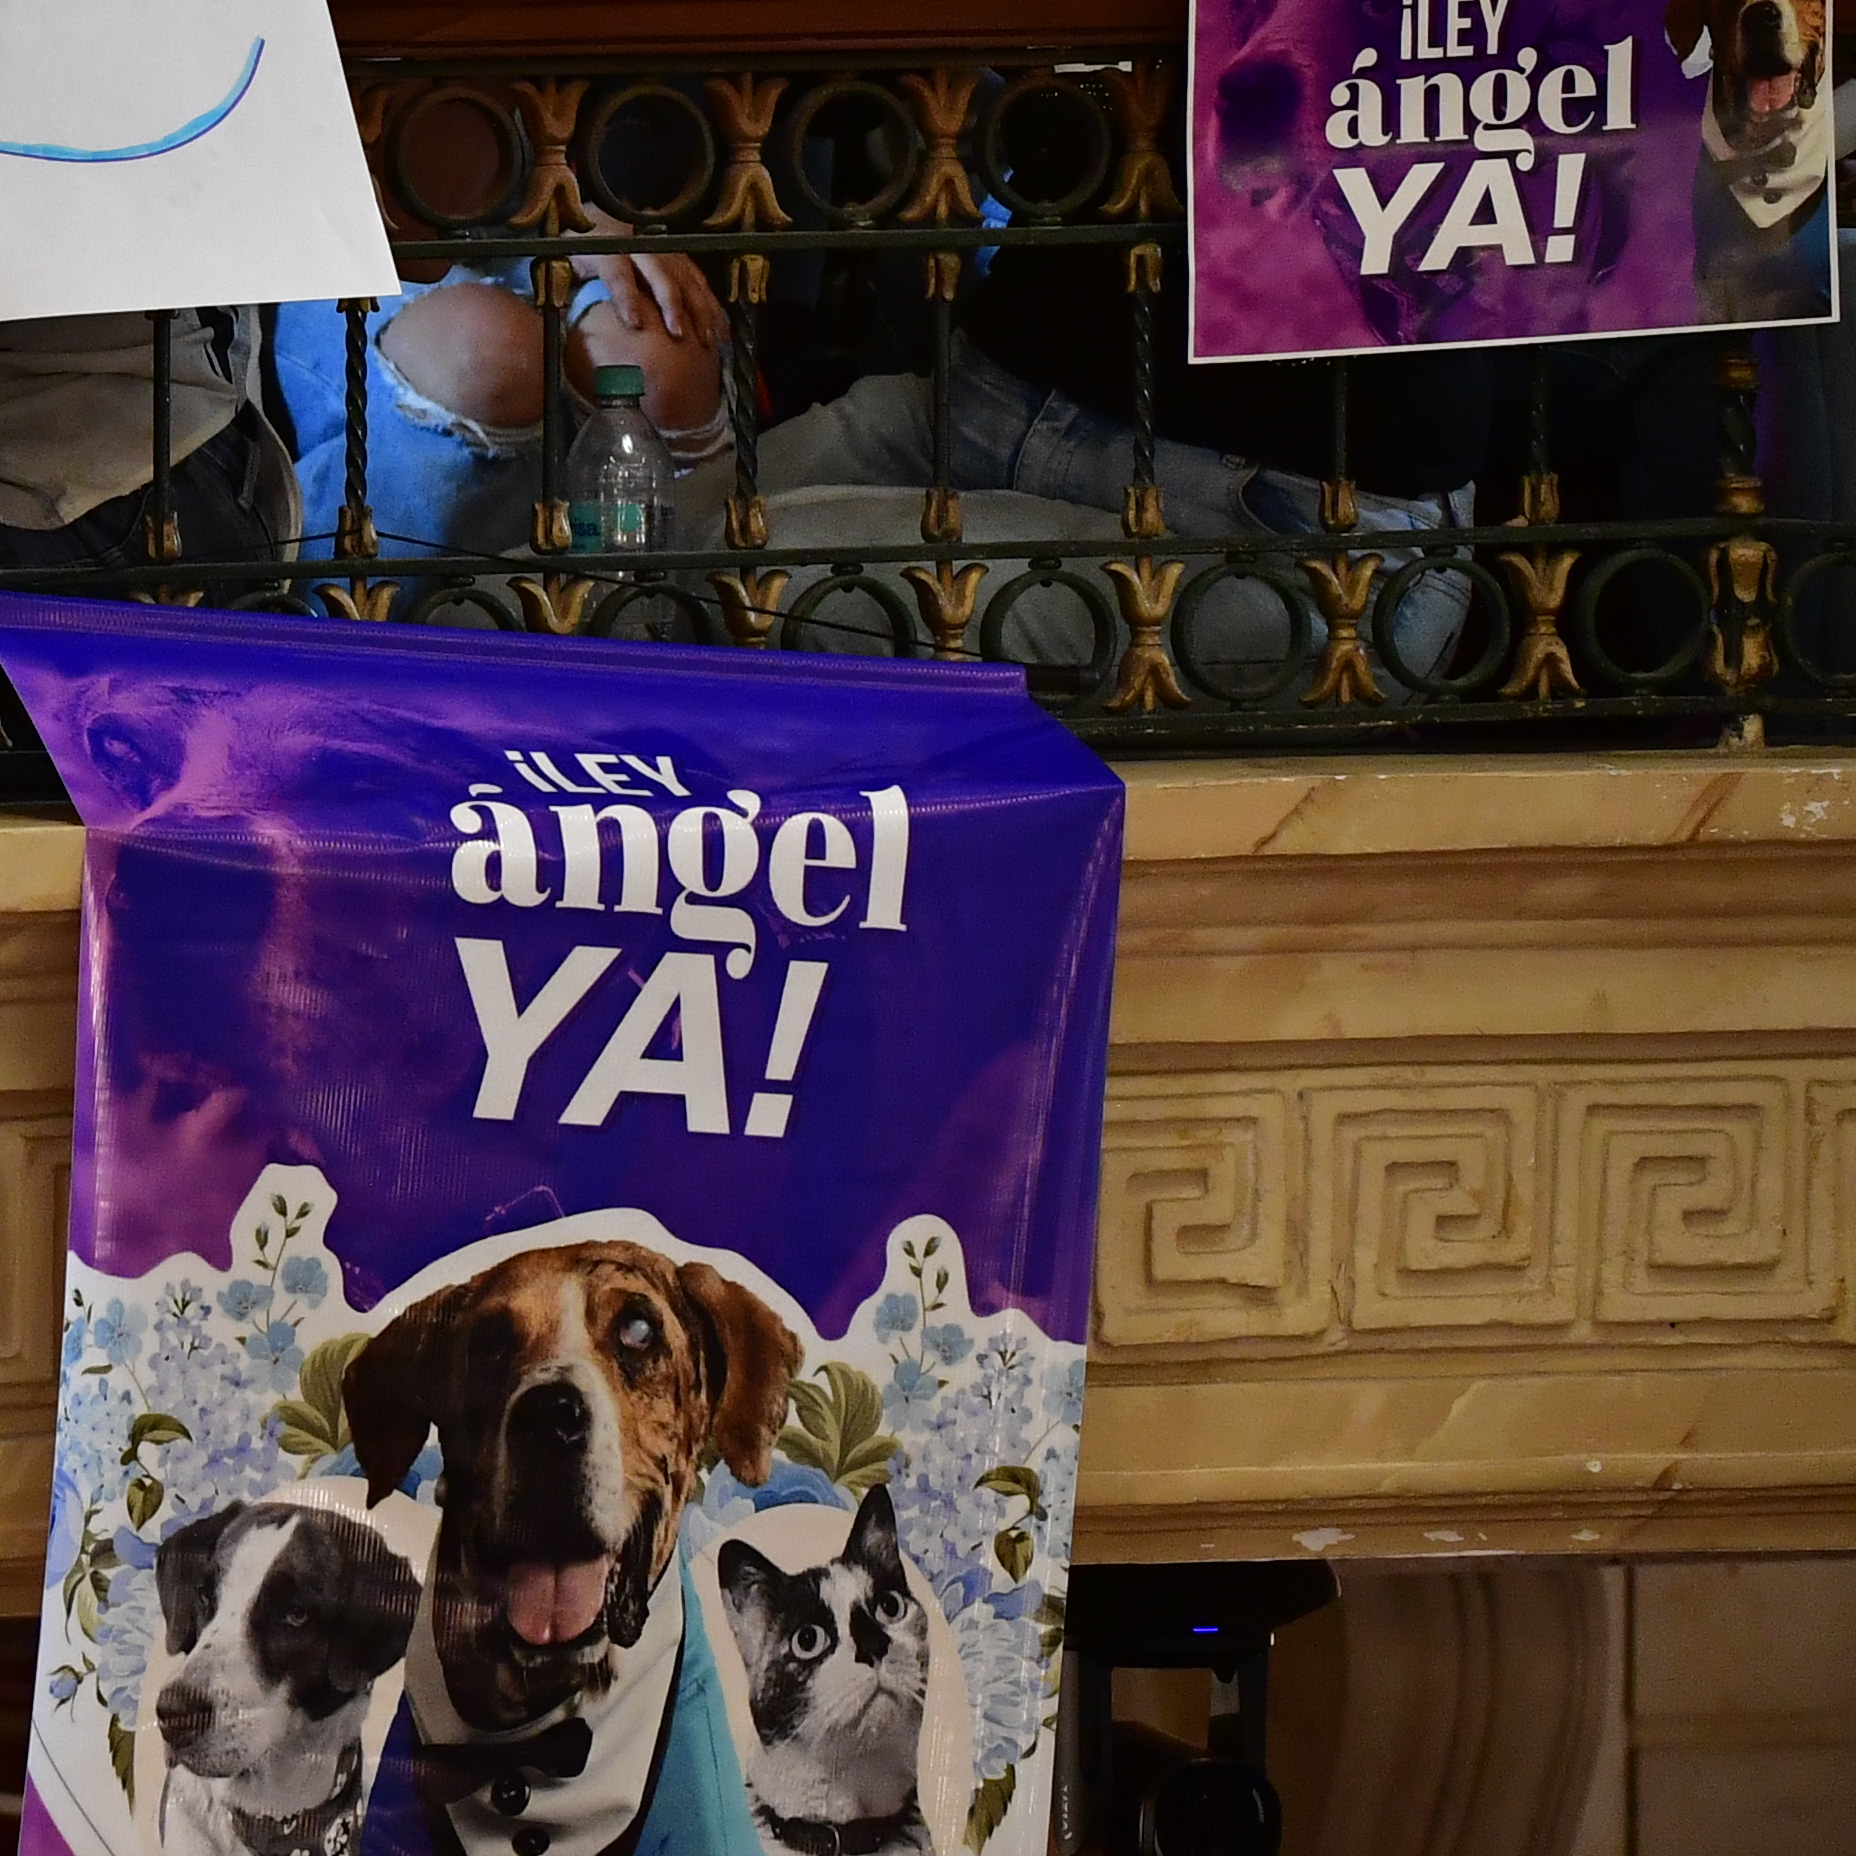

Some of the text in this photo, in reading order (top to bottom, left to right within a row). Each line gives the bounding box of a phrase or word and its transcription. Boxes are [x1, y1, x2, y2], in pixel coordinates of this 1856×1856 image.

[1324, 35, 1637, 172] ángel
[1331, 152, 1586, 276] YA!
[449, 784, 910, 980] ángel
[454, 936, 829, 1138] YA!
